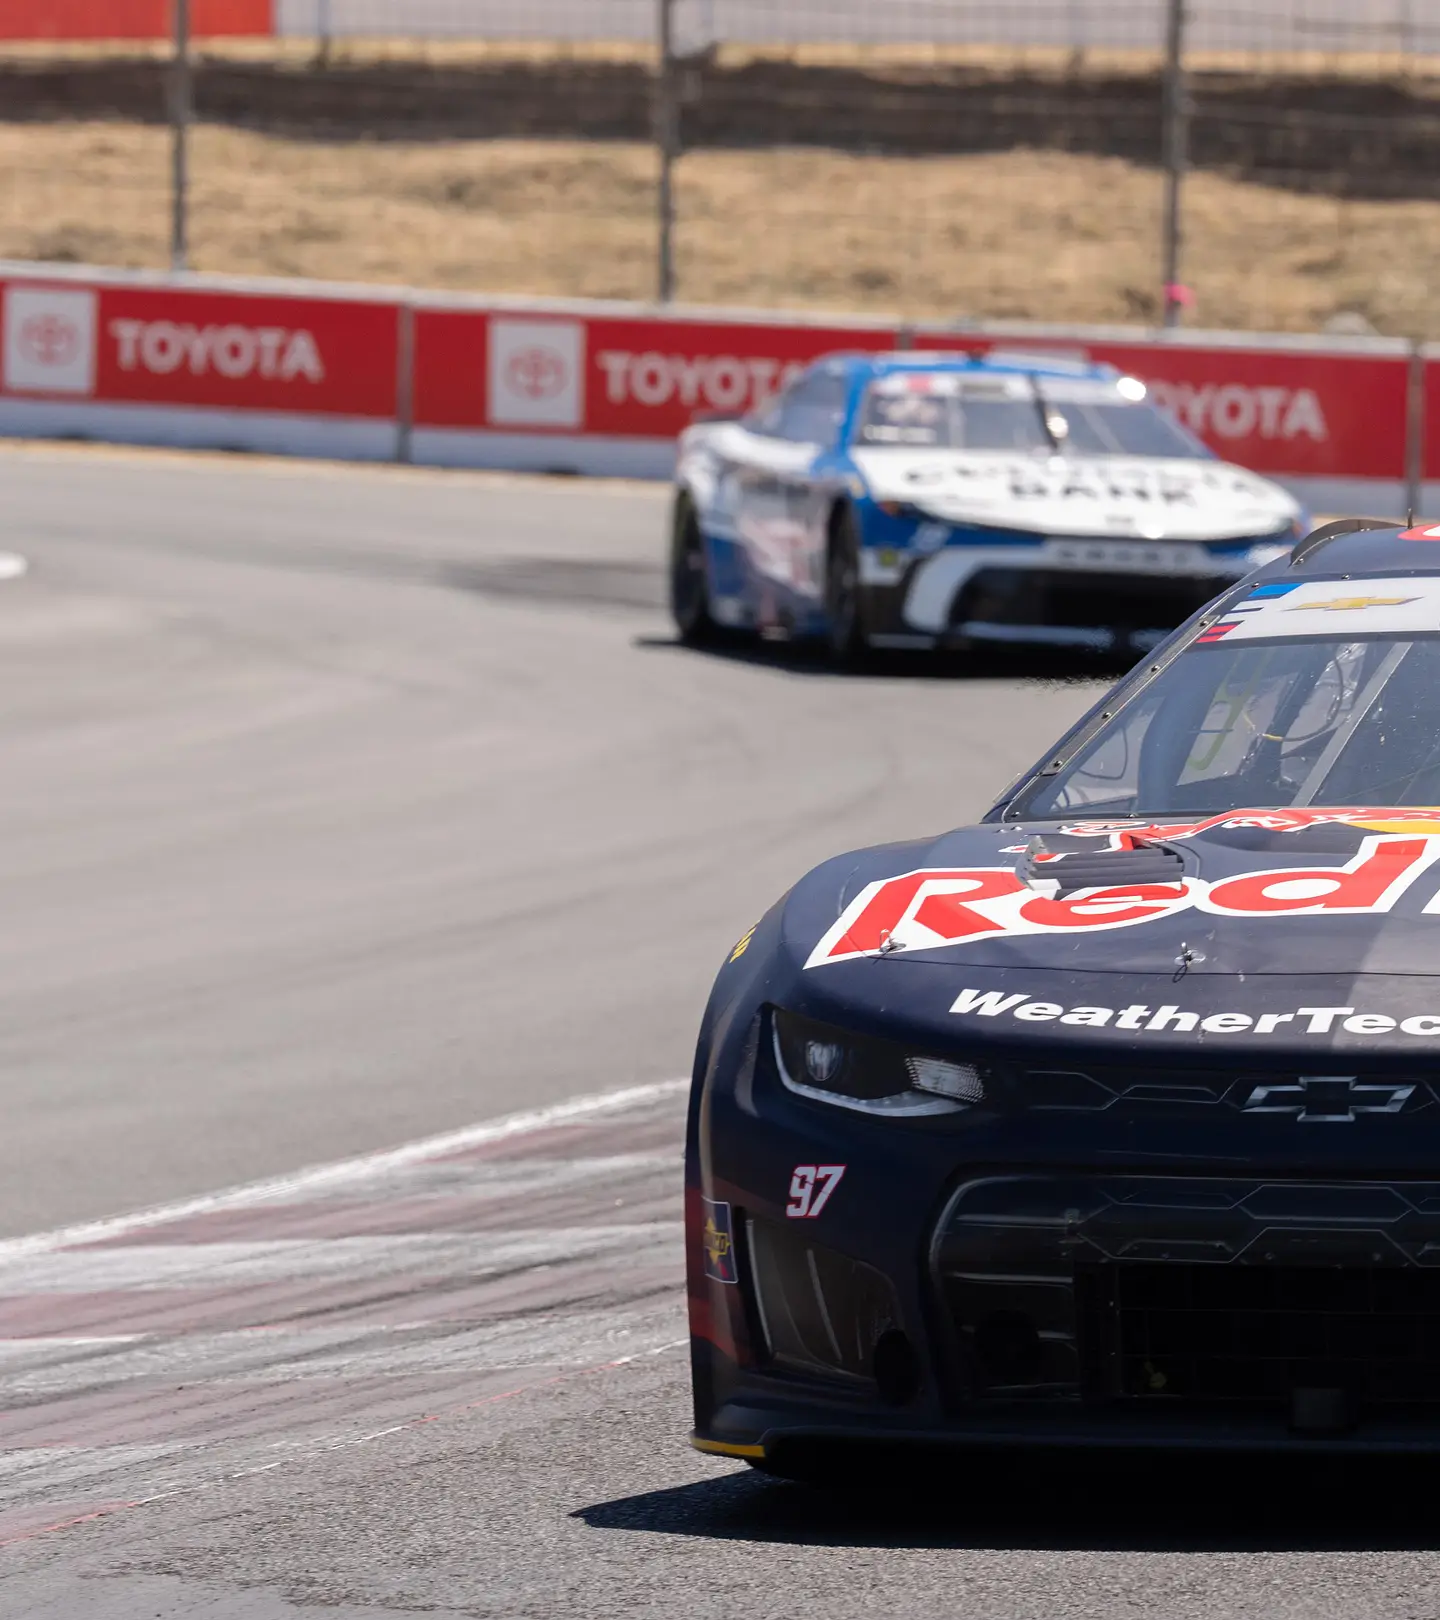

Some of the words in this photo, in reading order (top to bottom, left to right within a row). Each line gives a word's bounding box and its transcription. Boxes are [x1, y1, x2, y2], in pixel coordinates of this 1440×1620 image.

[109, 318, 324, 383] TOYOTA
[1150, 379, 1328, 441] YOTA
[803, 833, 1432, 969] Red
[786, 1164, 847, 1219] 97
